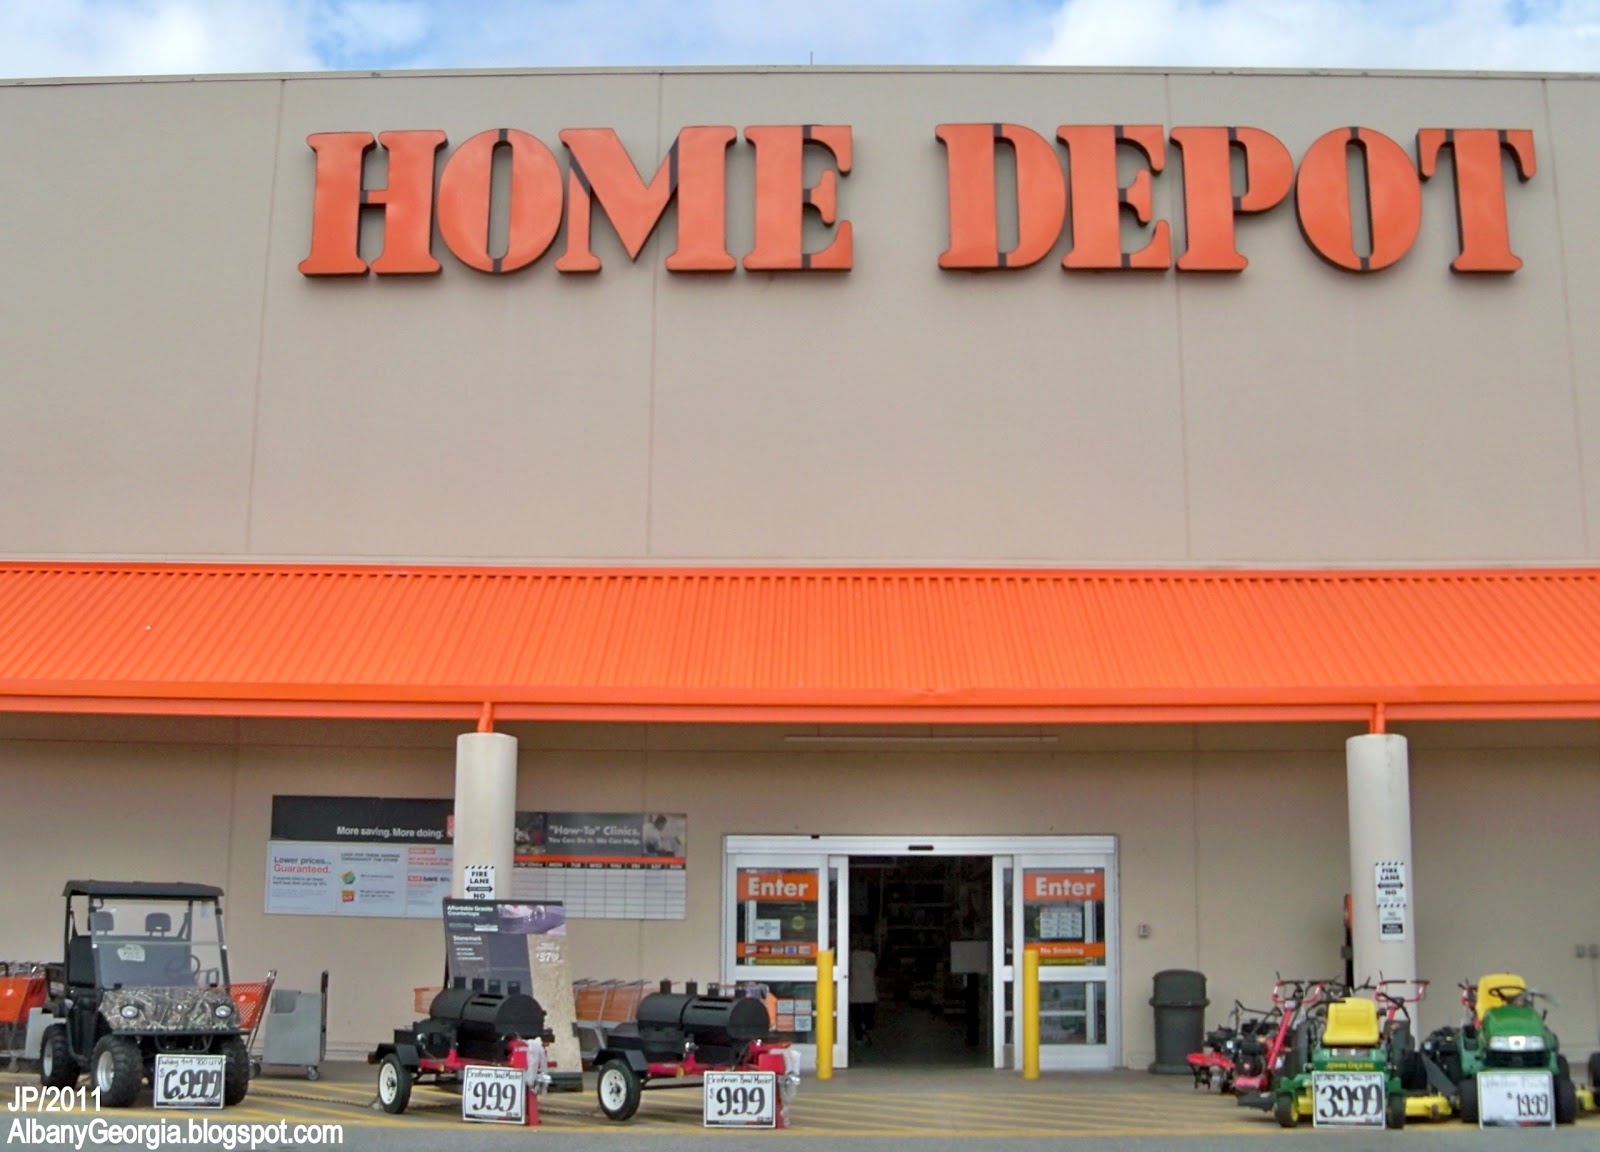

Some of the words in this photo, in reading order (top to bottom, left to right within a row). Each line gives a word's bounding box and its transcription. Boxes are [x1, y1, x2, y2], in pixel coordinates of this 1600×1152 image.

[298, 125, 852, 276] HOME
[935, 122, 1535, 274] DEPOT
[336, 826, 359, 836] More
[361, 827, 392, 838] saving.
[392, 828, 415, 837] More
[416, 828, 444, 839] doing.
[273, 864, 331, 874] Guaranteed.
[748, 877, 809, 897] Enter
[1035, 877, 1096, 896] Enter
[1040, 947, 1052, 955] No
[1053, 947, 1085, 956] Smoking
